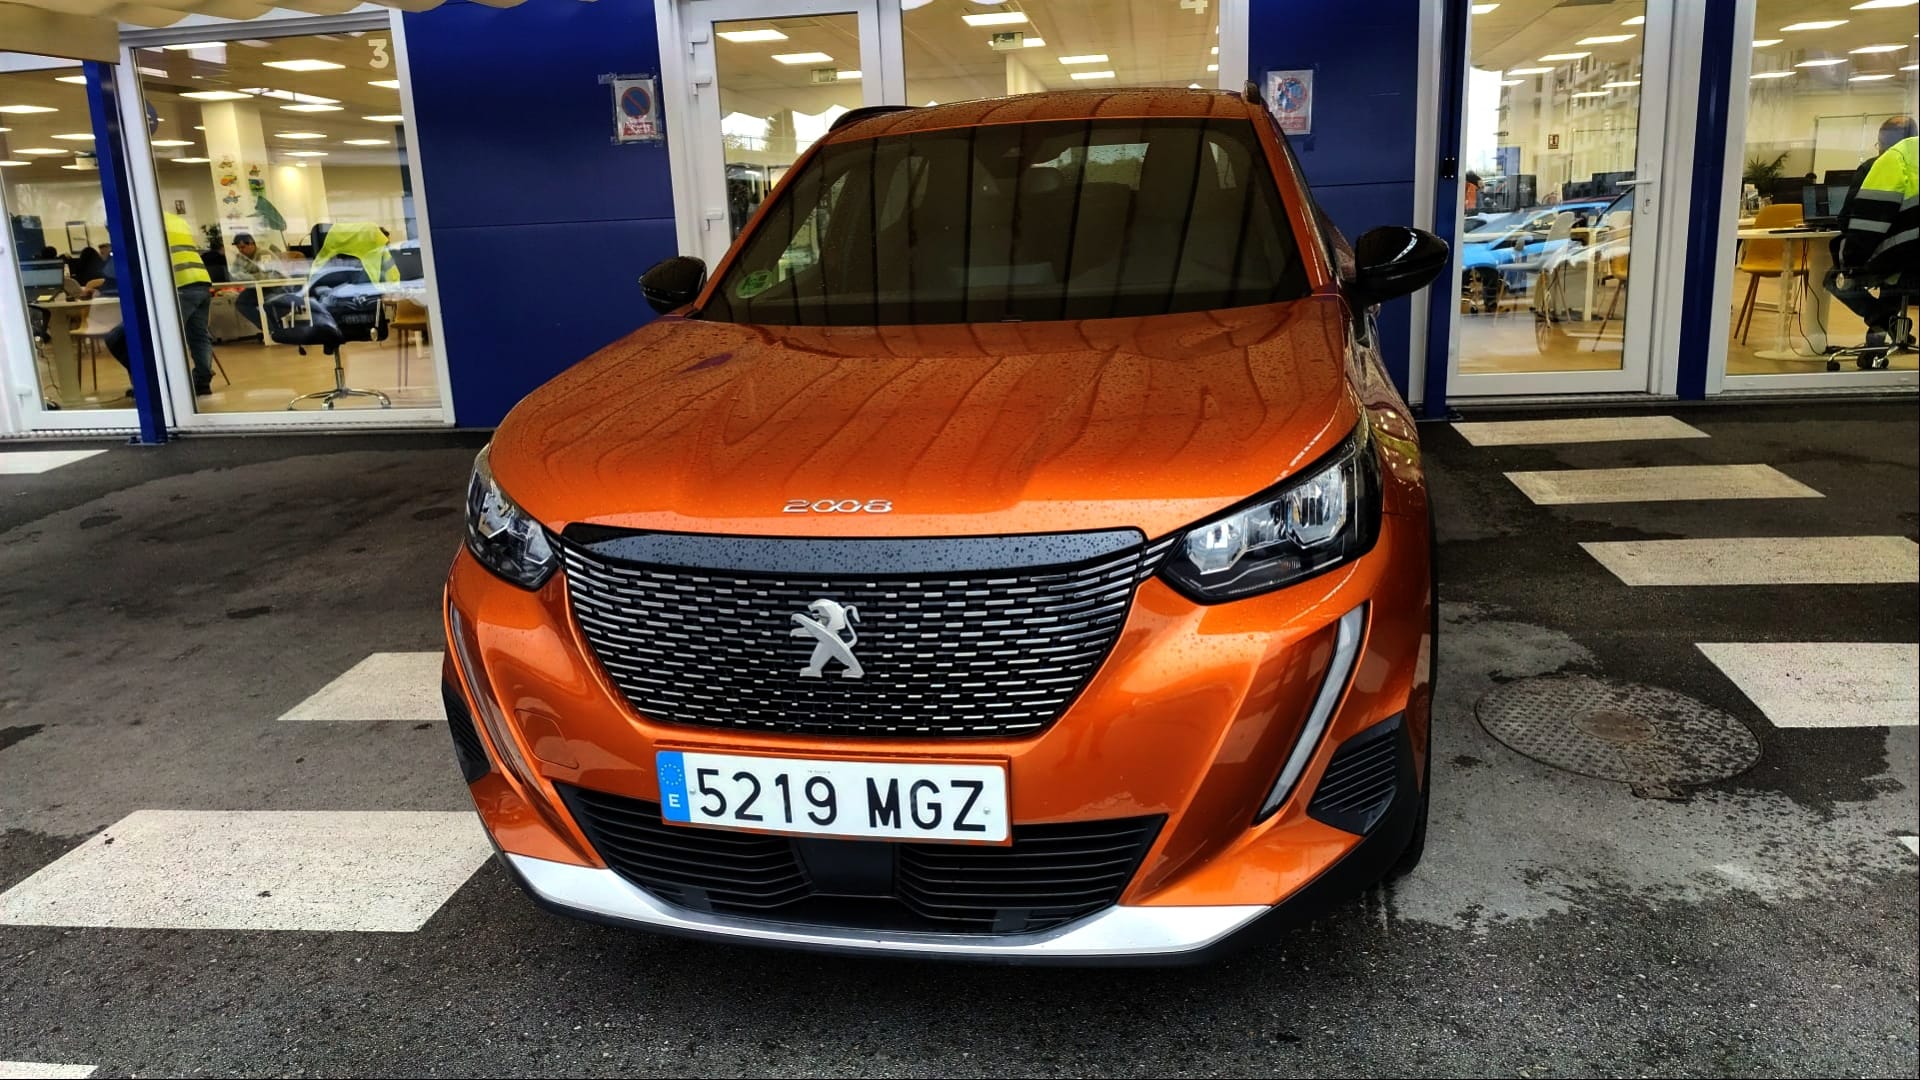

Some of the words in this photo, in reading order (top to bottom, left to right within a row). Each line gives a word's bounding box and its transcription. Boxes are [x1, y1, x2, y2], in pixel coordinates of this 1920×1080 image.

[368, 39, 389, 68] 3
[783, 499, 893, 513] 2008
[669, 794, 681, 808] E
[697, 768, 838, 826] 5219
[866, 777, 986, 832] MGZ
